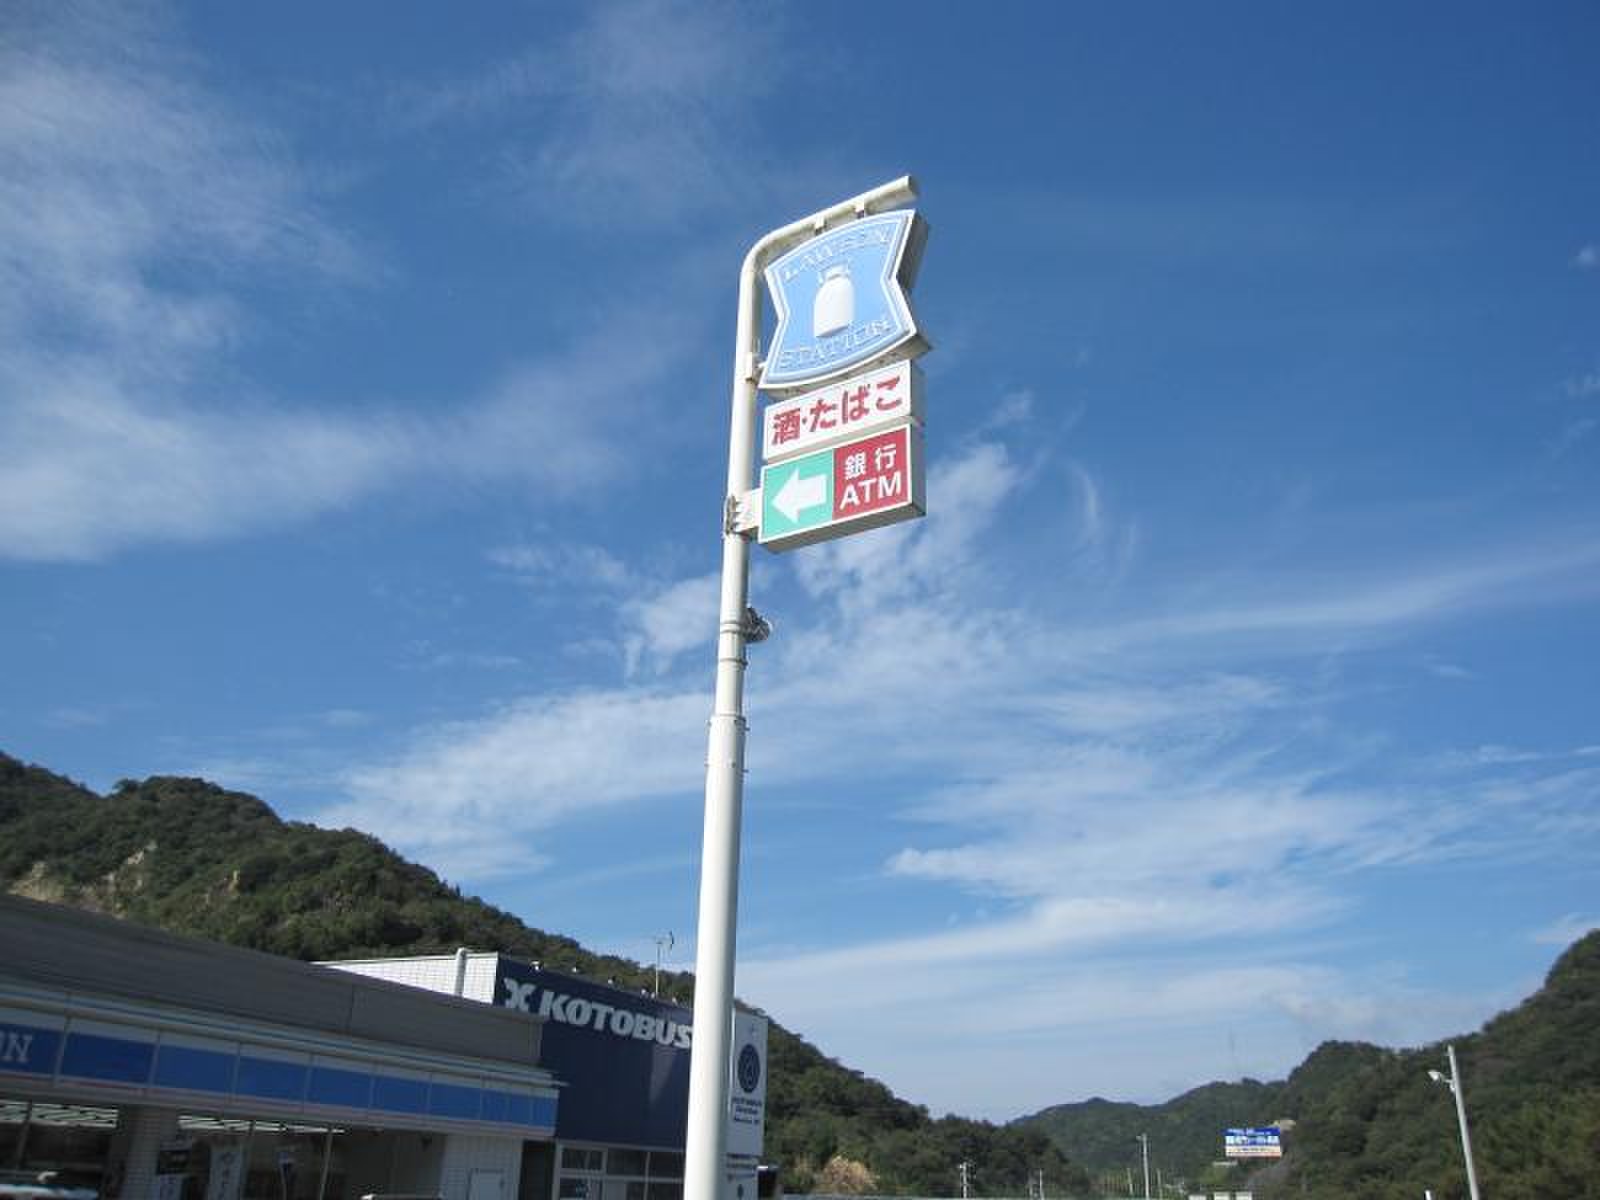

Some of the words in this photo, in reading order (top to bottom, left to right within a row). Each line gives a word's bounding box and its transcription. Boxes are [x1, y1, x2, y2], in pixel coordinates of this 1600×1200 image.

[844, 444, 897, 480] 銀行
[840, 471, 902, 510] ATM
[0, 1029, 33, 1063] N
